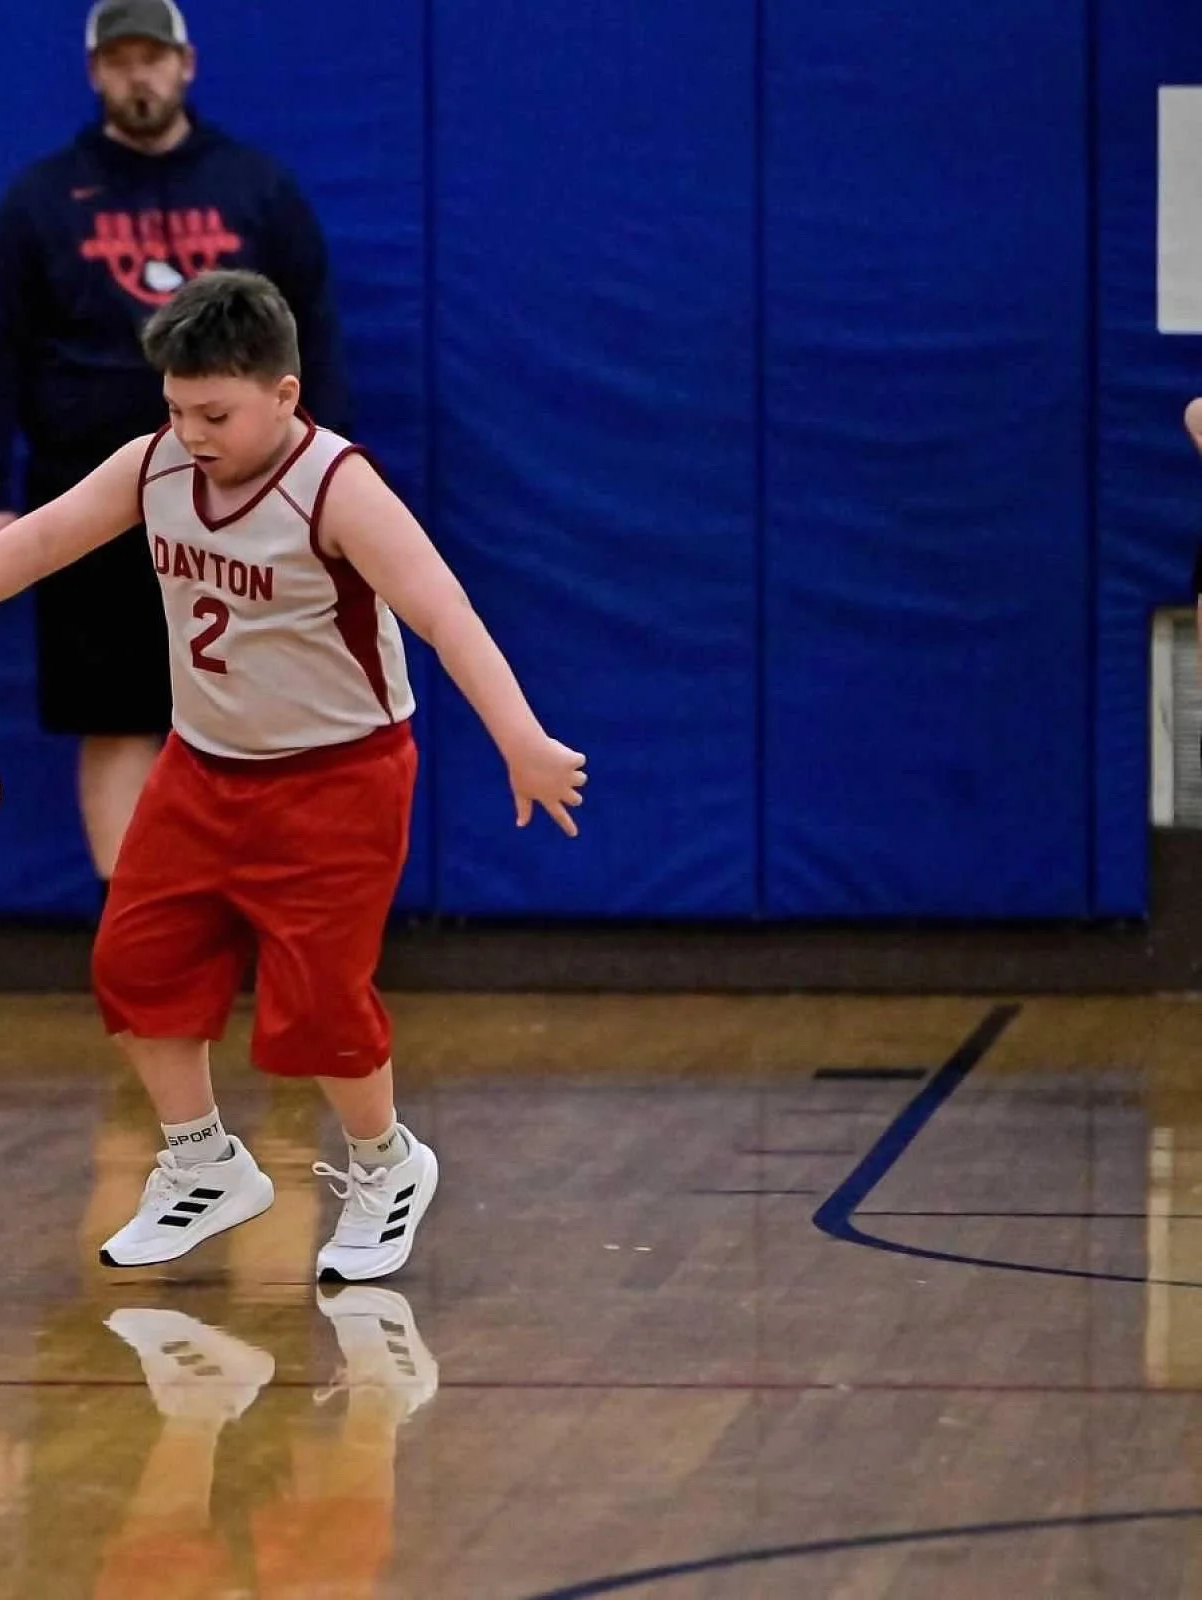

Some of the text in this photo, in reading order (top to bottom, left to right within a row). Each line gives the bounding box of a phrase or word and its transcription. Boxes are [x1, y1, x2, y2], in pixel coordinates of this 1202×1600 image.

[154, 534, 273, 601] DAYTON
[190, 596, 230, 674] 2
[168, 1122, 218, 1146] SPORT
